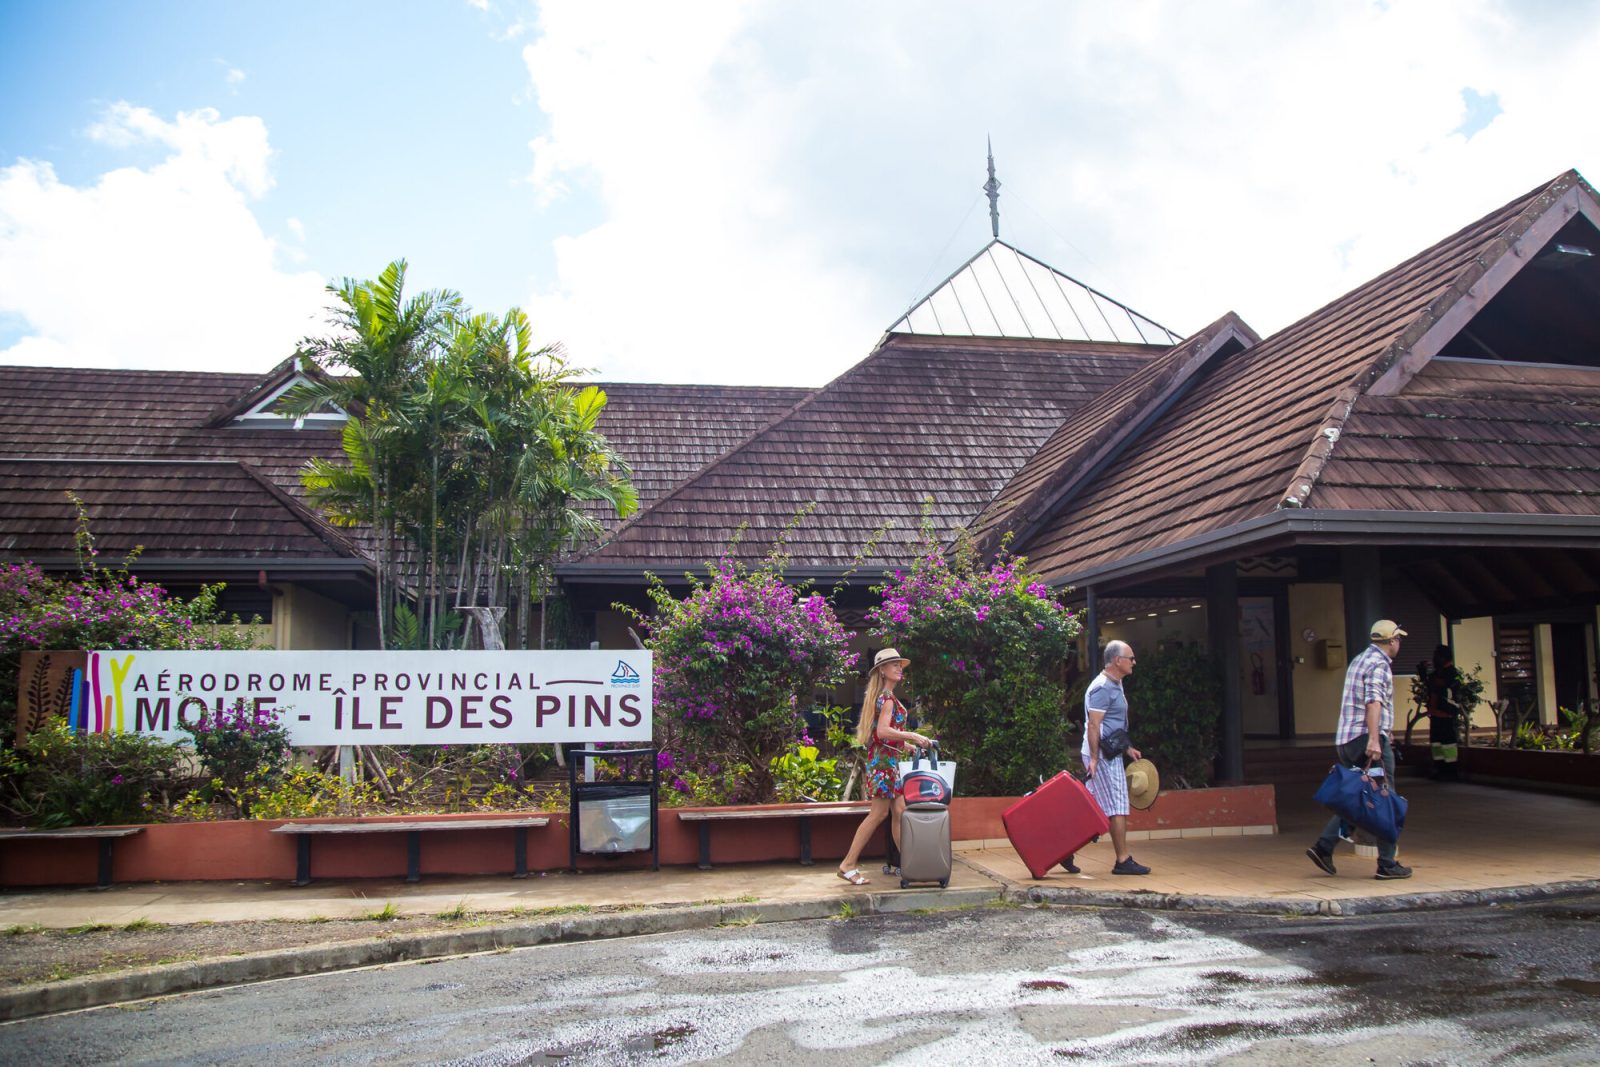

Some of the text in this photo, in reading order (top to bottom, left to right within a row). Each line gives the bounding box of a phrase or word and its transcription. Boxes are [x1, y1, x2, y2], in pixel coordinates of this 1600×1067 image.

[134, 668, 541, 692] AÉRODROME PROVINCIAL
[332, 688, 404, 730] ÎLE
[426, 695, 513, 729] DES
[536, 694, 642, 728] PINS
